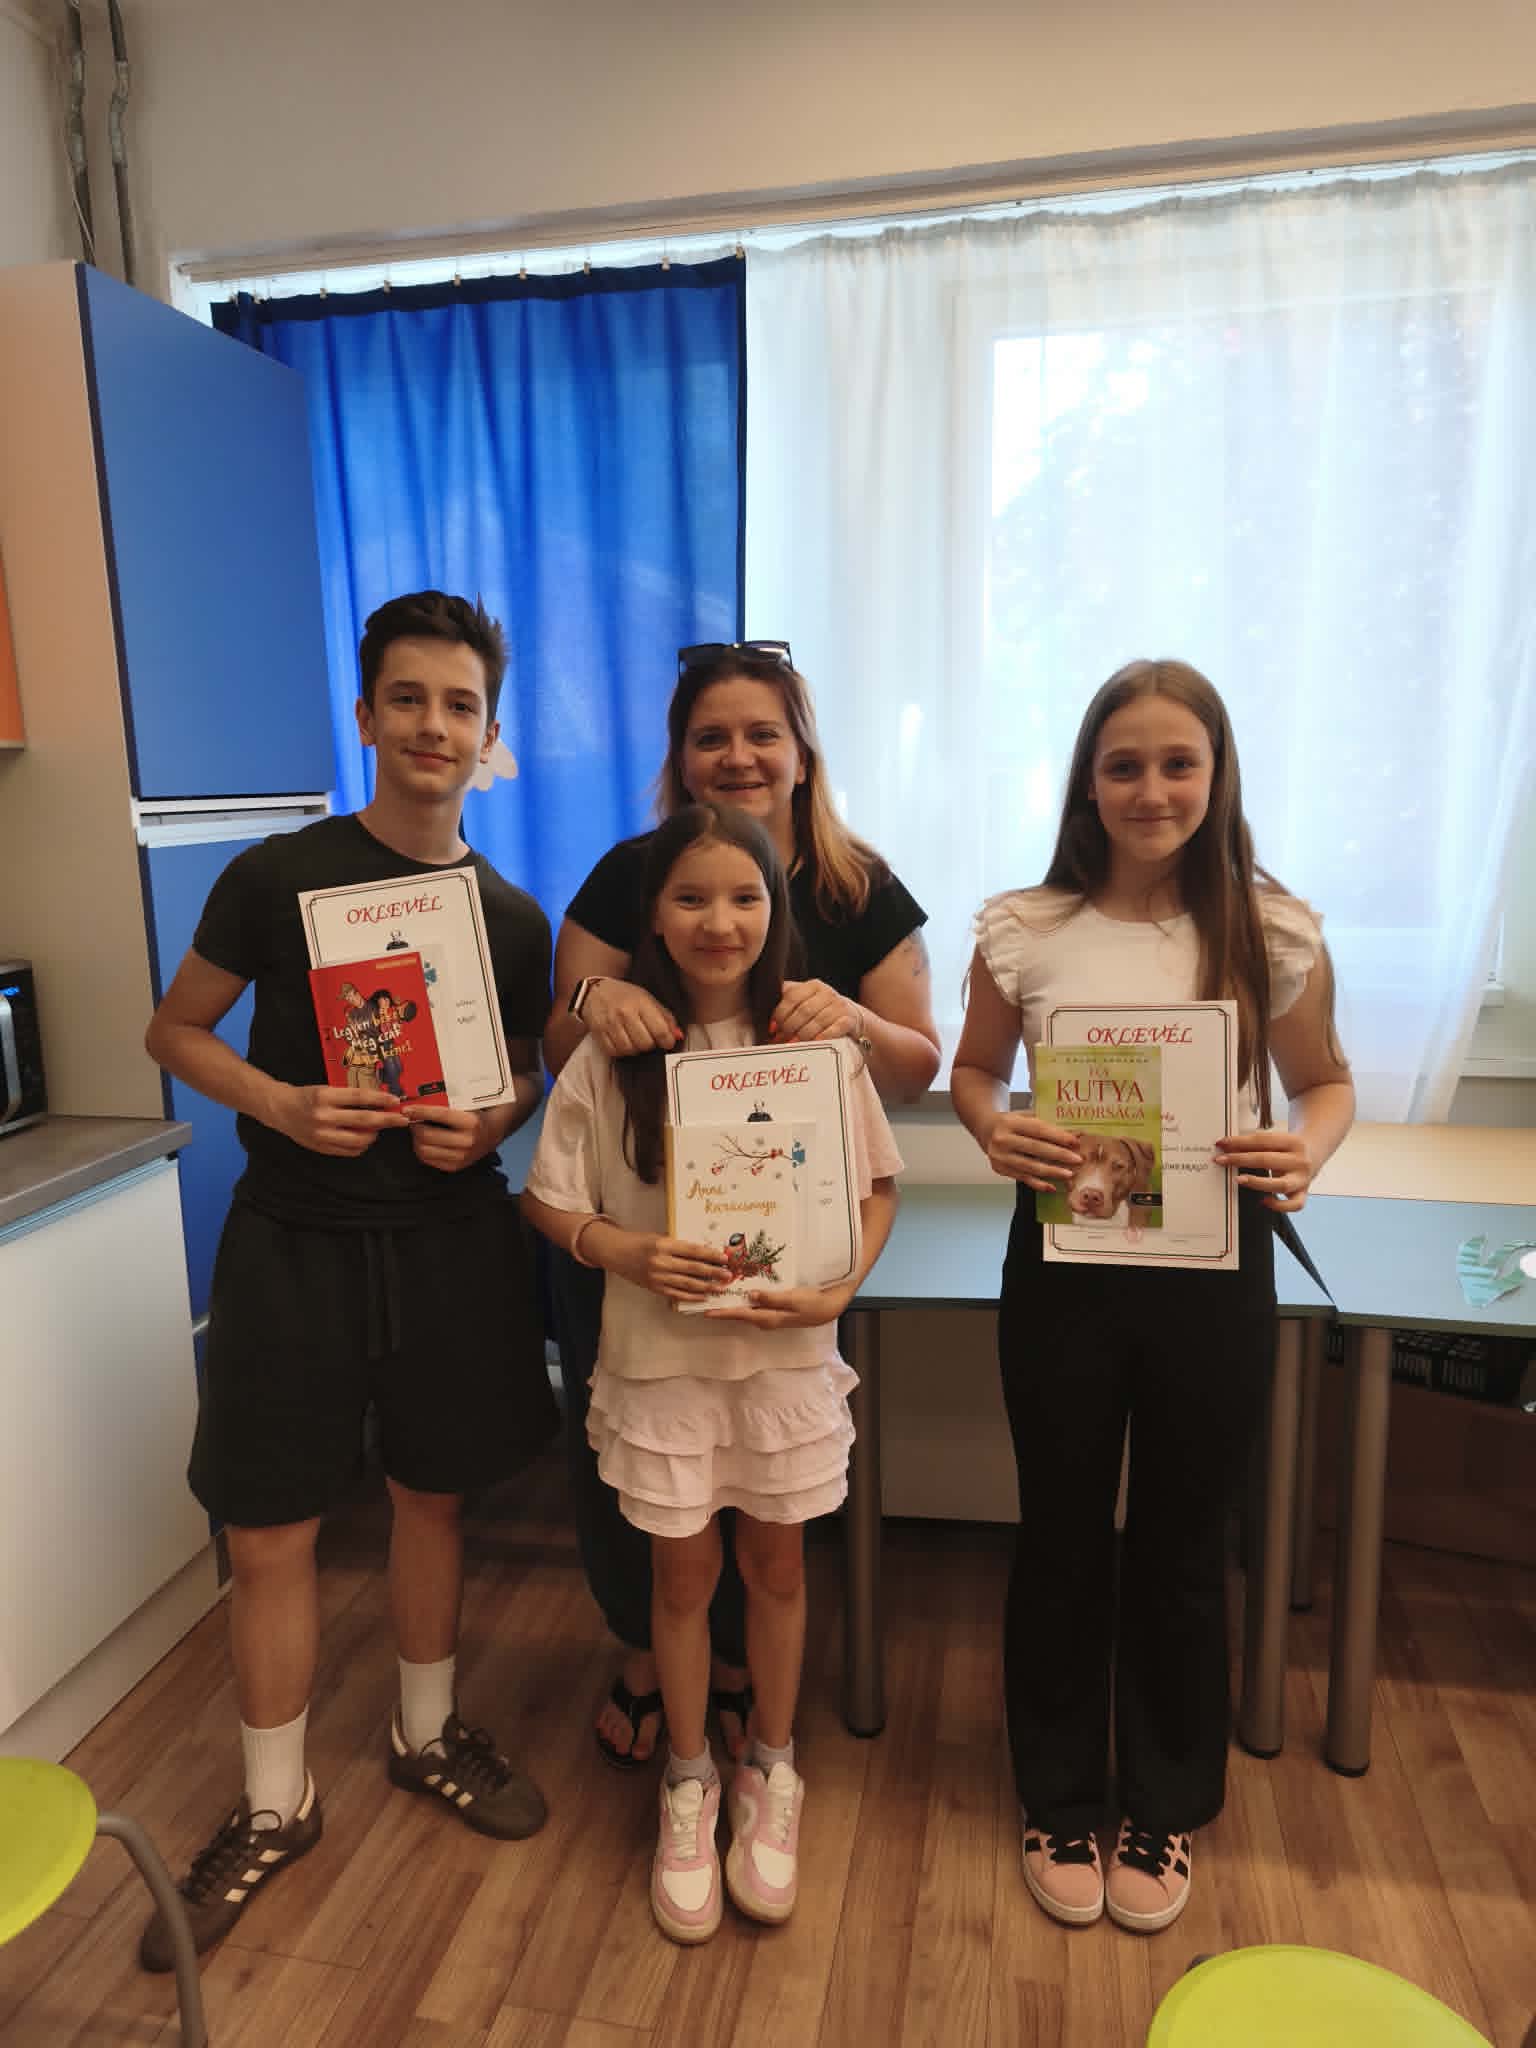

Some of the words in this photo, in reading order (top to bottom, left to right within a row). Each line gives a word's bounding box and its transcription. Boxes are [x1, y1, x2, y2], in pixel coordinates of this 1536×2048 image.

[346, 893, 442, 924] OKLEVÉL
[1087, 1023, 1193, 1047] OKLEVÉL
[711, 1064, 810, 1091] OKLEVÉL
[1057, 1079, 1145, 1102] KUTYA
